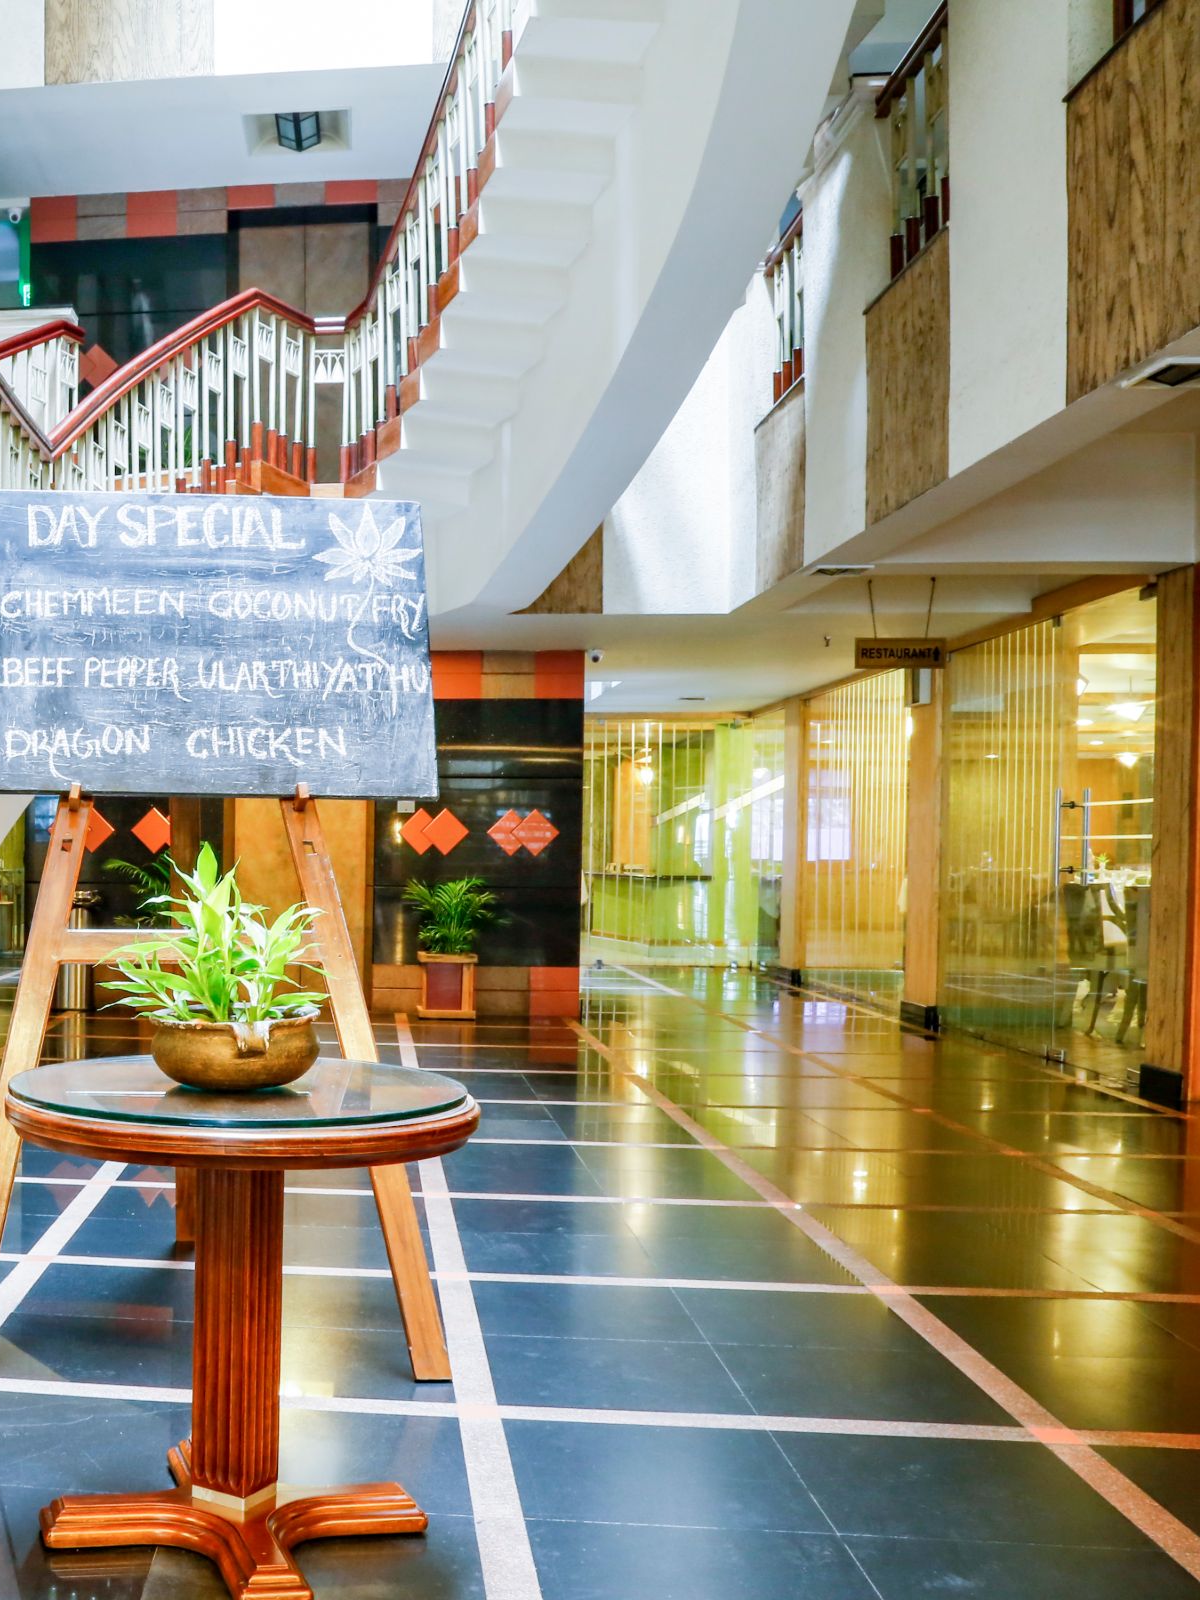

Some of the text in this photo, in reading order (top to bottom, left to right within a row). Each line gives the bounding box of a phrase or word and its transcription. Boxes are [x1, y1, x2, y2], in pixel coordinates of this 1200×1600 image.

[28, 503, 306, 550] DAY SPECIAL
[0, 588, 185, 619] CHEMMEEN
[372, 594, 424, 640] FRY
[861, 648, 933, 659] RESTAURANT
[3, 656, 73, 687] BEEF
[84, 656, 192, 702] PEPPER
[4, 725, 347, 779] DRAGON CHICKEN
